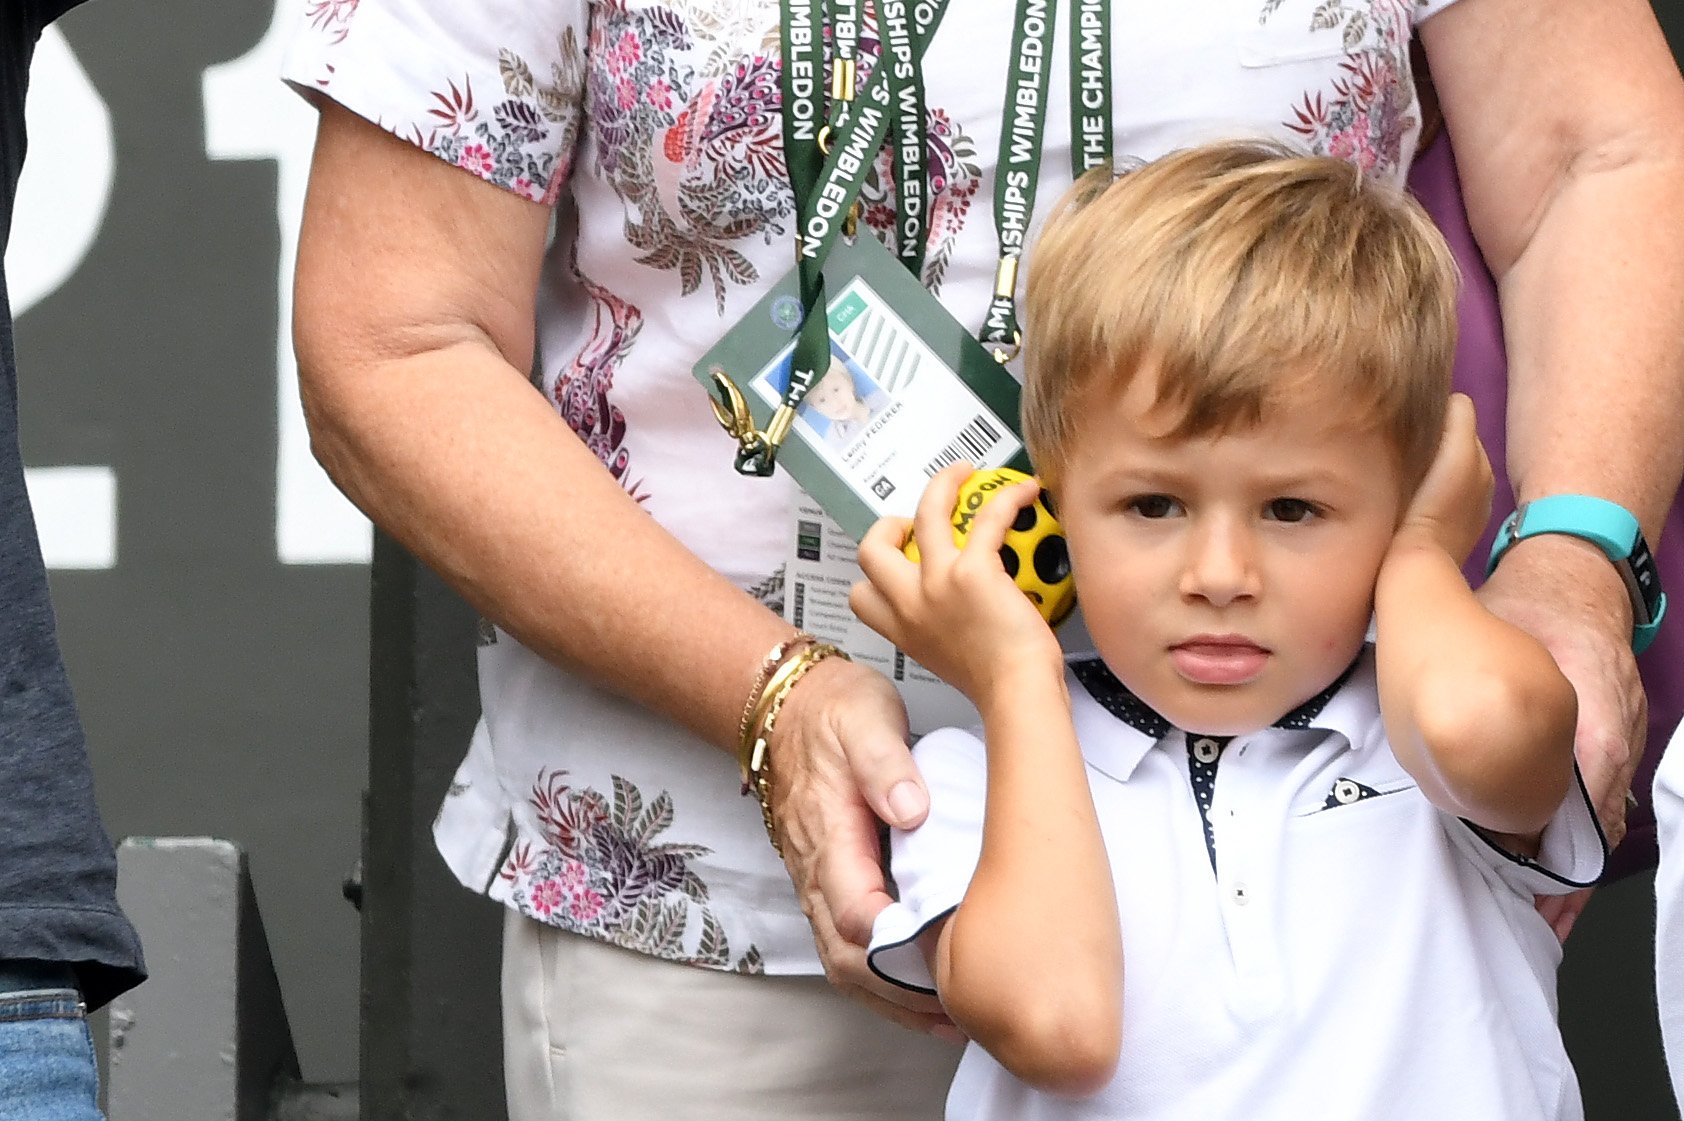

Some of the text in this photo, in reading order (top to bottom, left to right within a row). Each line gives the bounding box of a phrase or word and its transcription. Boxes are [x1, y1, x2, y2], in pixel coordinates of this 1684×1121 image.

[1082, 115, 1106, 170] THE
[801, 106, 884, 260] WIMBLEDON
[897, 84, 921, 259] WIMBLEDON
[788, 369, 815, 406] TH
[865, 400, 904, 439] FEDERER
